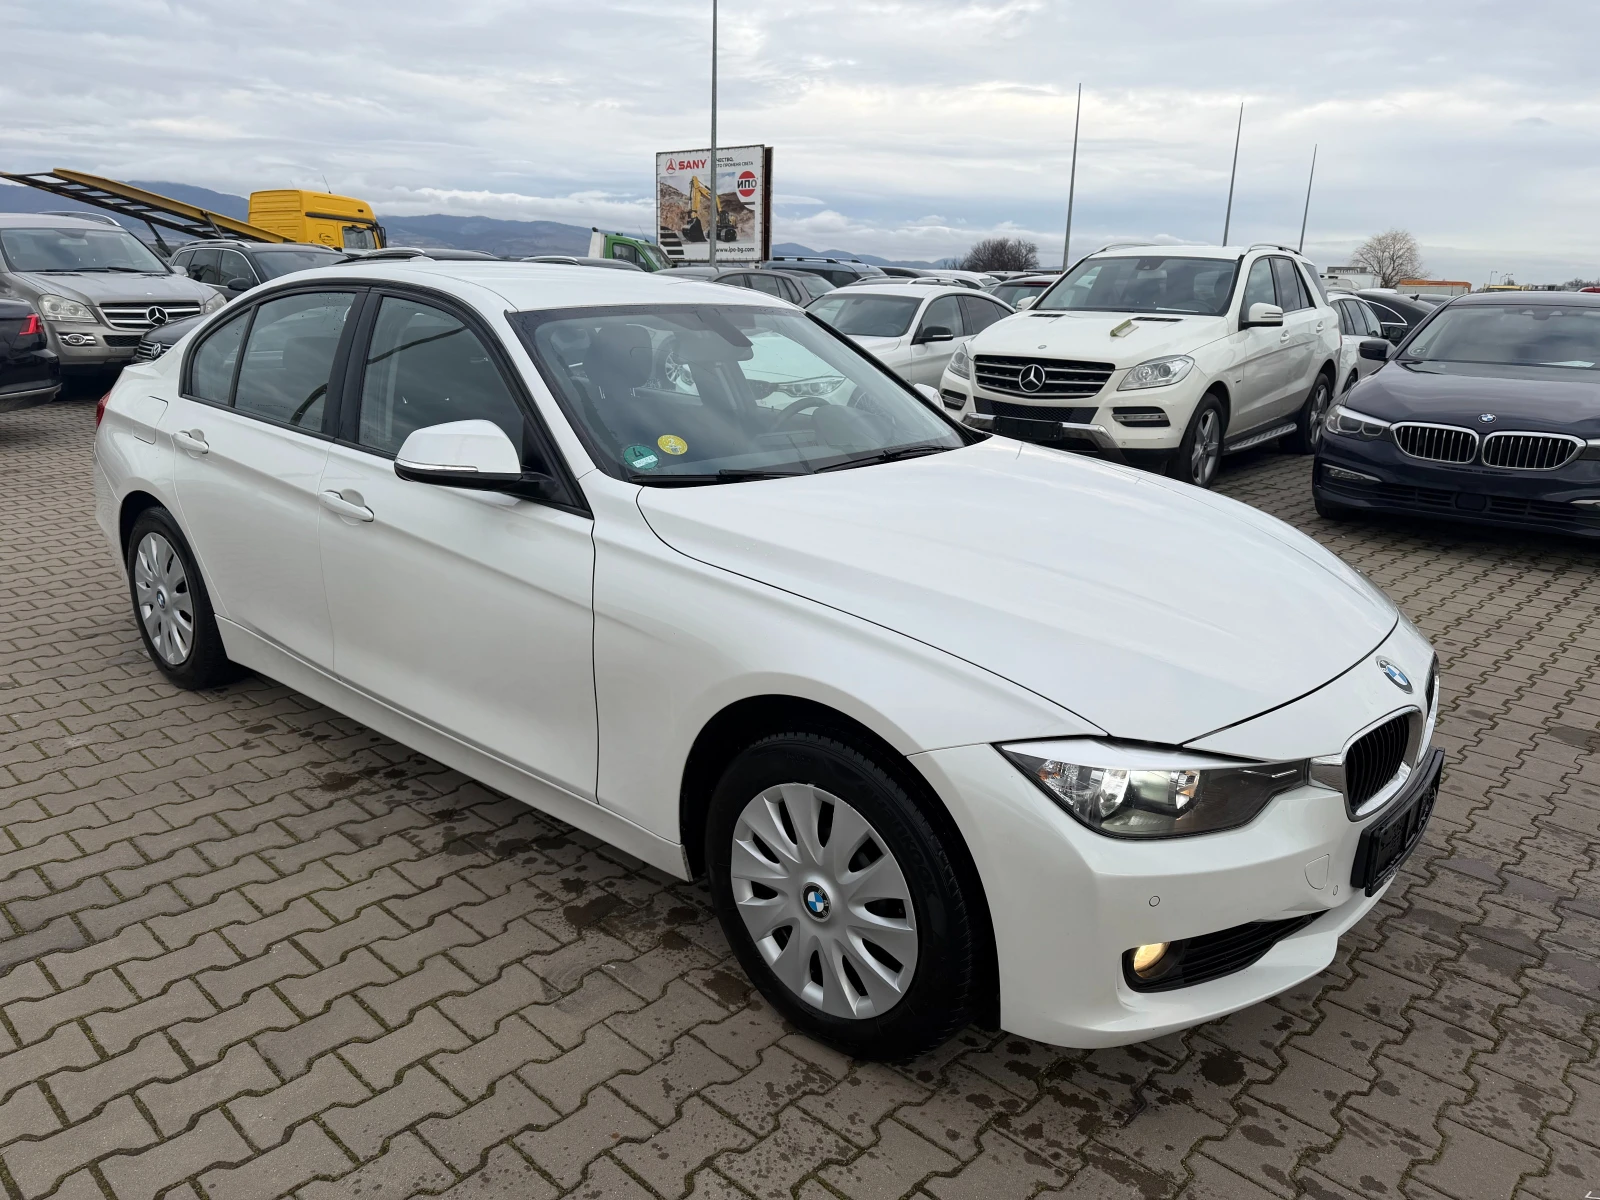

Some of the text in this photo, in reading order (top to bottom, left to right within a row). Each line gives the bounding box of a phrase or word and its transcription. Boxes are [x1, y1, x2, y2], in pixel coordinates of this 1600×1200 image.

[678, 158, 707, 170] SANY
[737, 179, 757, 189] ИПО
[632, 447, 644, 458] 4
